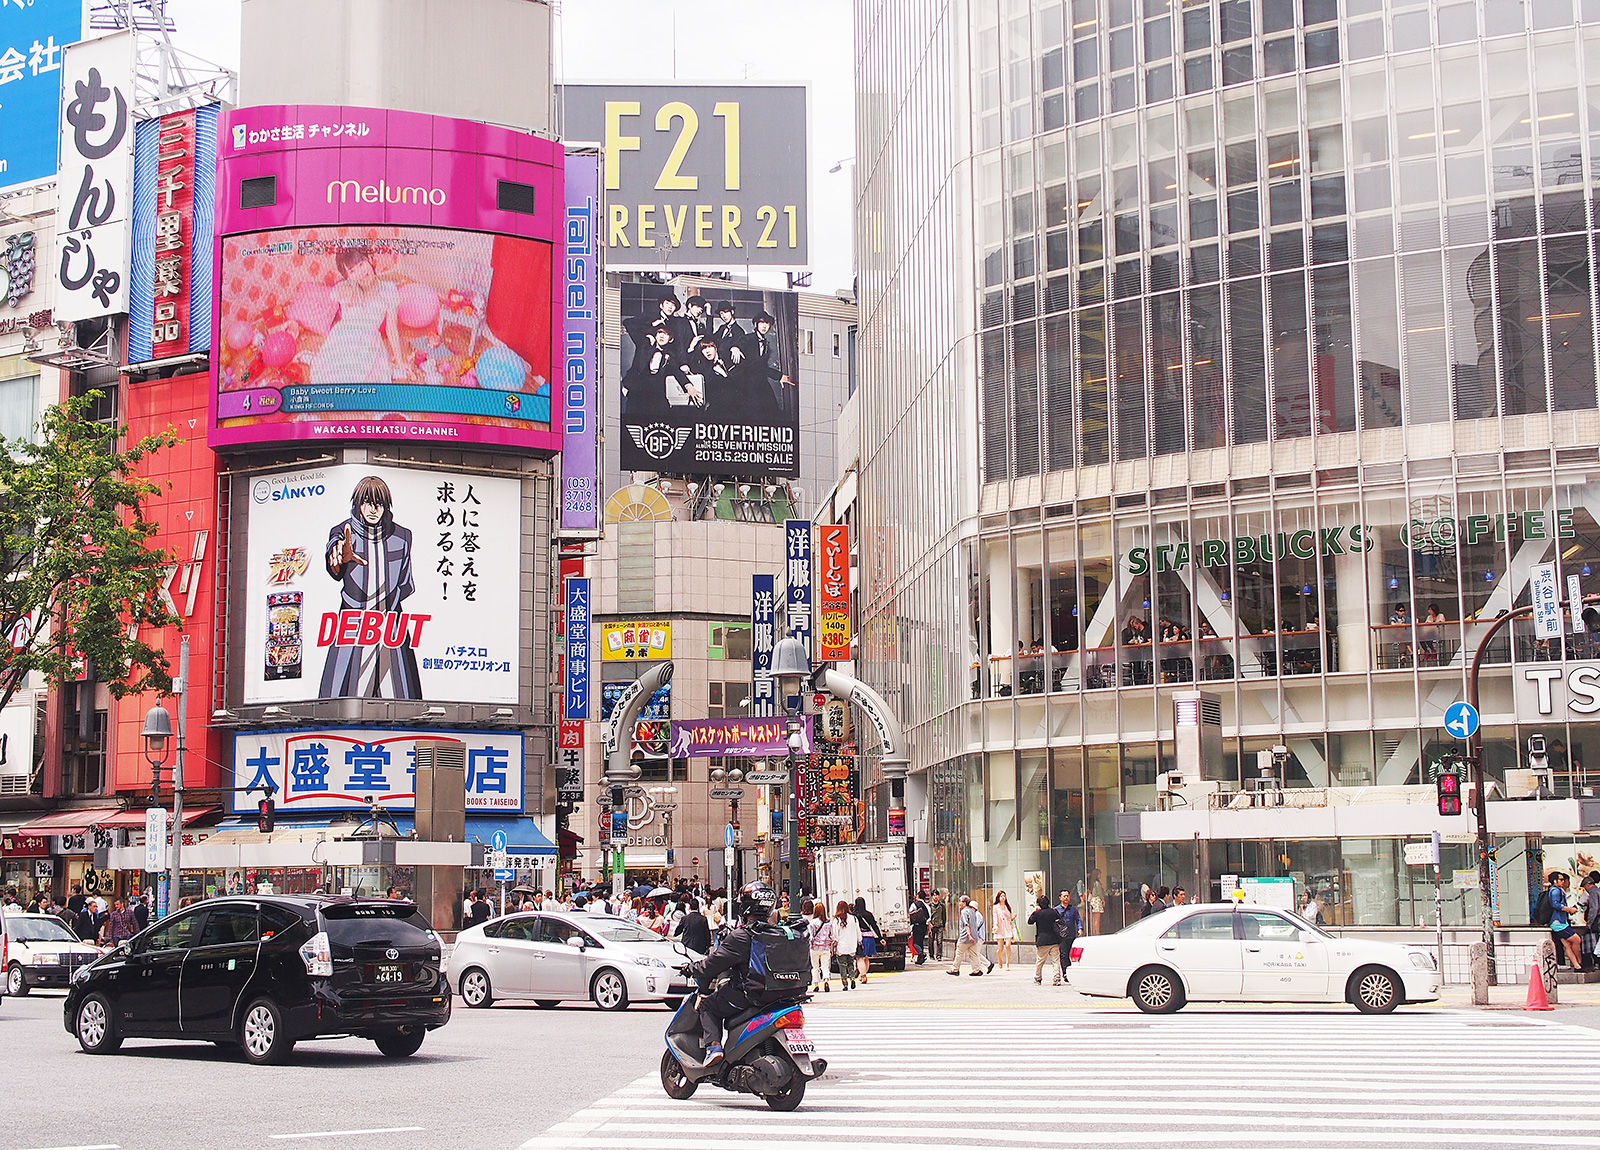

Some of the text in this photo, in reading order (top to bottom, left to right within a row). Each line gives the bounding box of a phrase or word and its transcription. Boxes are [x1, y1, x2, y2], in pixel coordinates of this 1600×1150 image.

[249, 122, 369, 144] わかさ生活 チャンネル
[605, 101, 740, 190] F21
[60, 68, 128, 308] もんじゃ
[327, 179, 446, 206] Melumo
[153, 118, 185, 345] 三千里薬品
[610, 204, 798, 248] REVER 21
[565, 196, 592, 434] Taisei neon
[242, 394, 251, 410] 4
[290, 388, 308, 396] Baby
[313, 425, 459, 436] WAKASA SEIKATSU CHANNEL
[695, 424, 793, 443] BOYFRIEND
[650, 436, 669, 453] BF
[712, 440, 754, 450] SEVENTH
[757, 443, 793, 452] MISSION
[695, 451, 793, 464] 2013.5.29 ON SALE
[272, 477, 285, 485] Good
[300, 473, 315, 482] Good
[567, 476, 591, 489] (03)
[272, 484, 325, 501] SANKYO
[566, 490, 592, 500] 3719
[566, 501, 592, 511] 2468
[436, 481, 456, 601] 求めるな!
[461, 484, 481, 602] 人に答えを
[1127, 507, 1576, 575] STARBUCKS COFFEE
[1534, 580, 1542, 609] Shibuya
[1541, 569, 1558, 632] 渋谷駅前
[822, 612, 848, 621] ハンバーグ
[825, 621, 846, 632] 140g
[316, 609, 431, 649] DEBUT
[624, 629, 650, 644] 麻雀
[445, 646, 487, 658] パチスロ
[569, 587, 587, 710] 大盛堂商事ビル
[828, 650, 843, 659] 4F
[1525, 666, 1600, 714] TS
[608, 684, 639, 749] 渋谷センター街
[691, 723, 787, 745] バスケットボールストリー
[245, 742, 509, 795] 大盛堂店
[466, 797, 518, 806] BOOKS TAISEIDO
[149, 813, 158, 862] 文化村通り
[380, 971, 402, 982] 64-19
